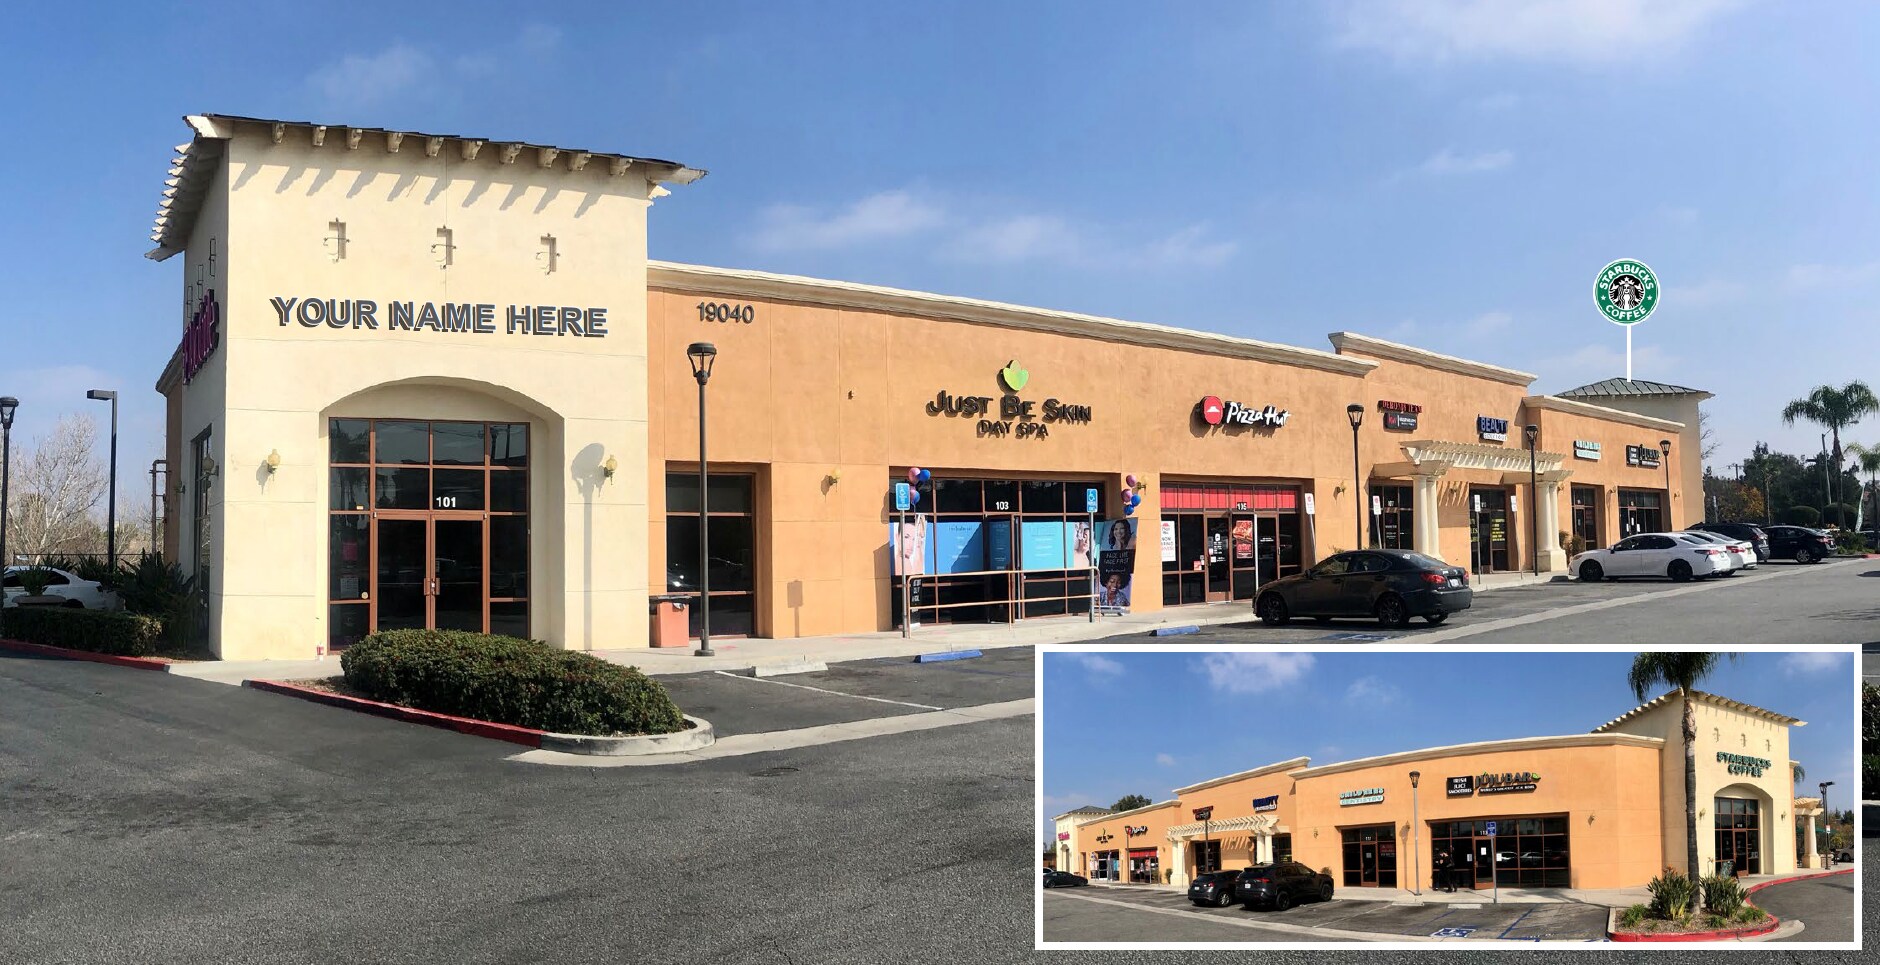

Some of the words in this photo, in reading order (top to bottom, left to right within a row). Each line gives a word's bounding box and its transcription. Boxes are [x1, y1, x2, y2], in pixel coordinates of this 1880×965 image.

[697, 301, 755, 324] 19040
[1226, 401, 1263, 425] Pizza
[1265, 406, 1291, 426] Hut
[977, 419, 1013, 438] DAY
[1015, 422, 1049, 440] SPA
[1480, 416, 1508, 433] BEAUTY
[436, 496, 457, 508] 101
[996, 501, 1009, 511] 103
[1717, 752, 1771, 769] STARBUCKS
[1728, 764, 1763, 778] COFFEE
